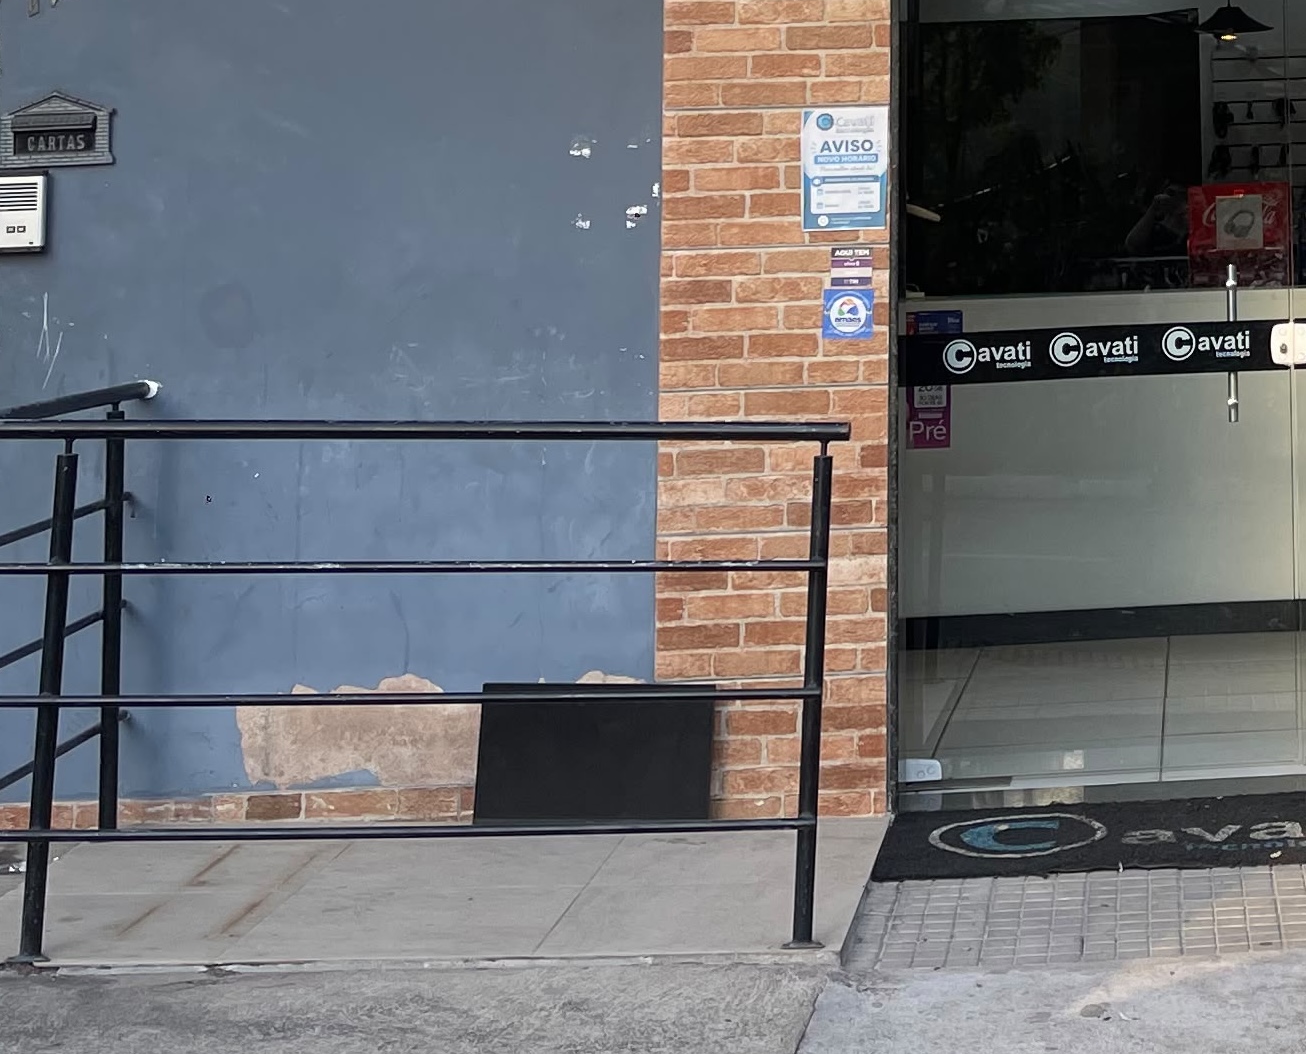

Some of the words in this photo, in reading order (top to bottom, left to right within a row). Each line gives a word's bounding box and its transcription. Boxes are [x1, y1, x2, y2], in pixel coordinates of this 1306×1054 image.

[27, 134, 85, 152] CARTAS
[820, 139, 874, 153] AVISO
[817, 155, 840, 164] NOVO
[1049, 332, 1139, 367] Cavati
[1162, 326, 1250, 361] Cavati
[943, 339, 1032, 374] Cavati
[909, 420, 947, 441] Pré
